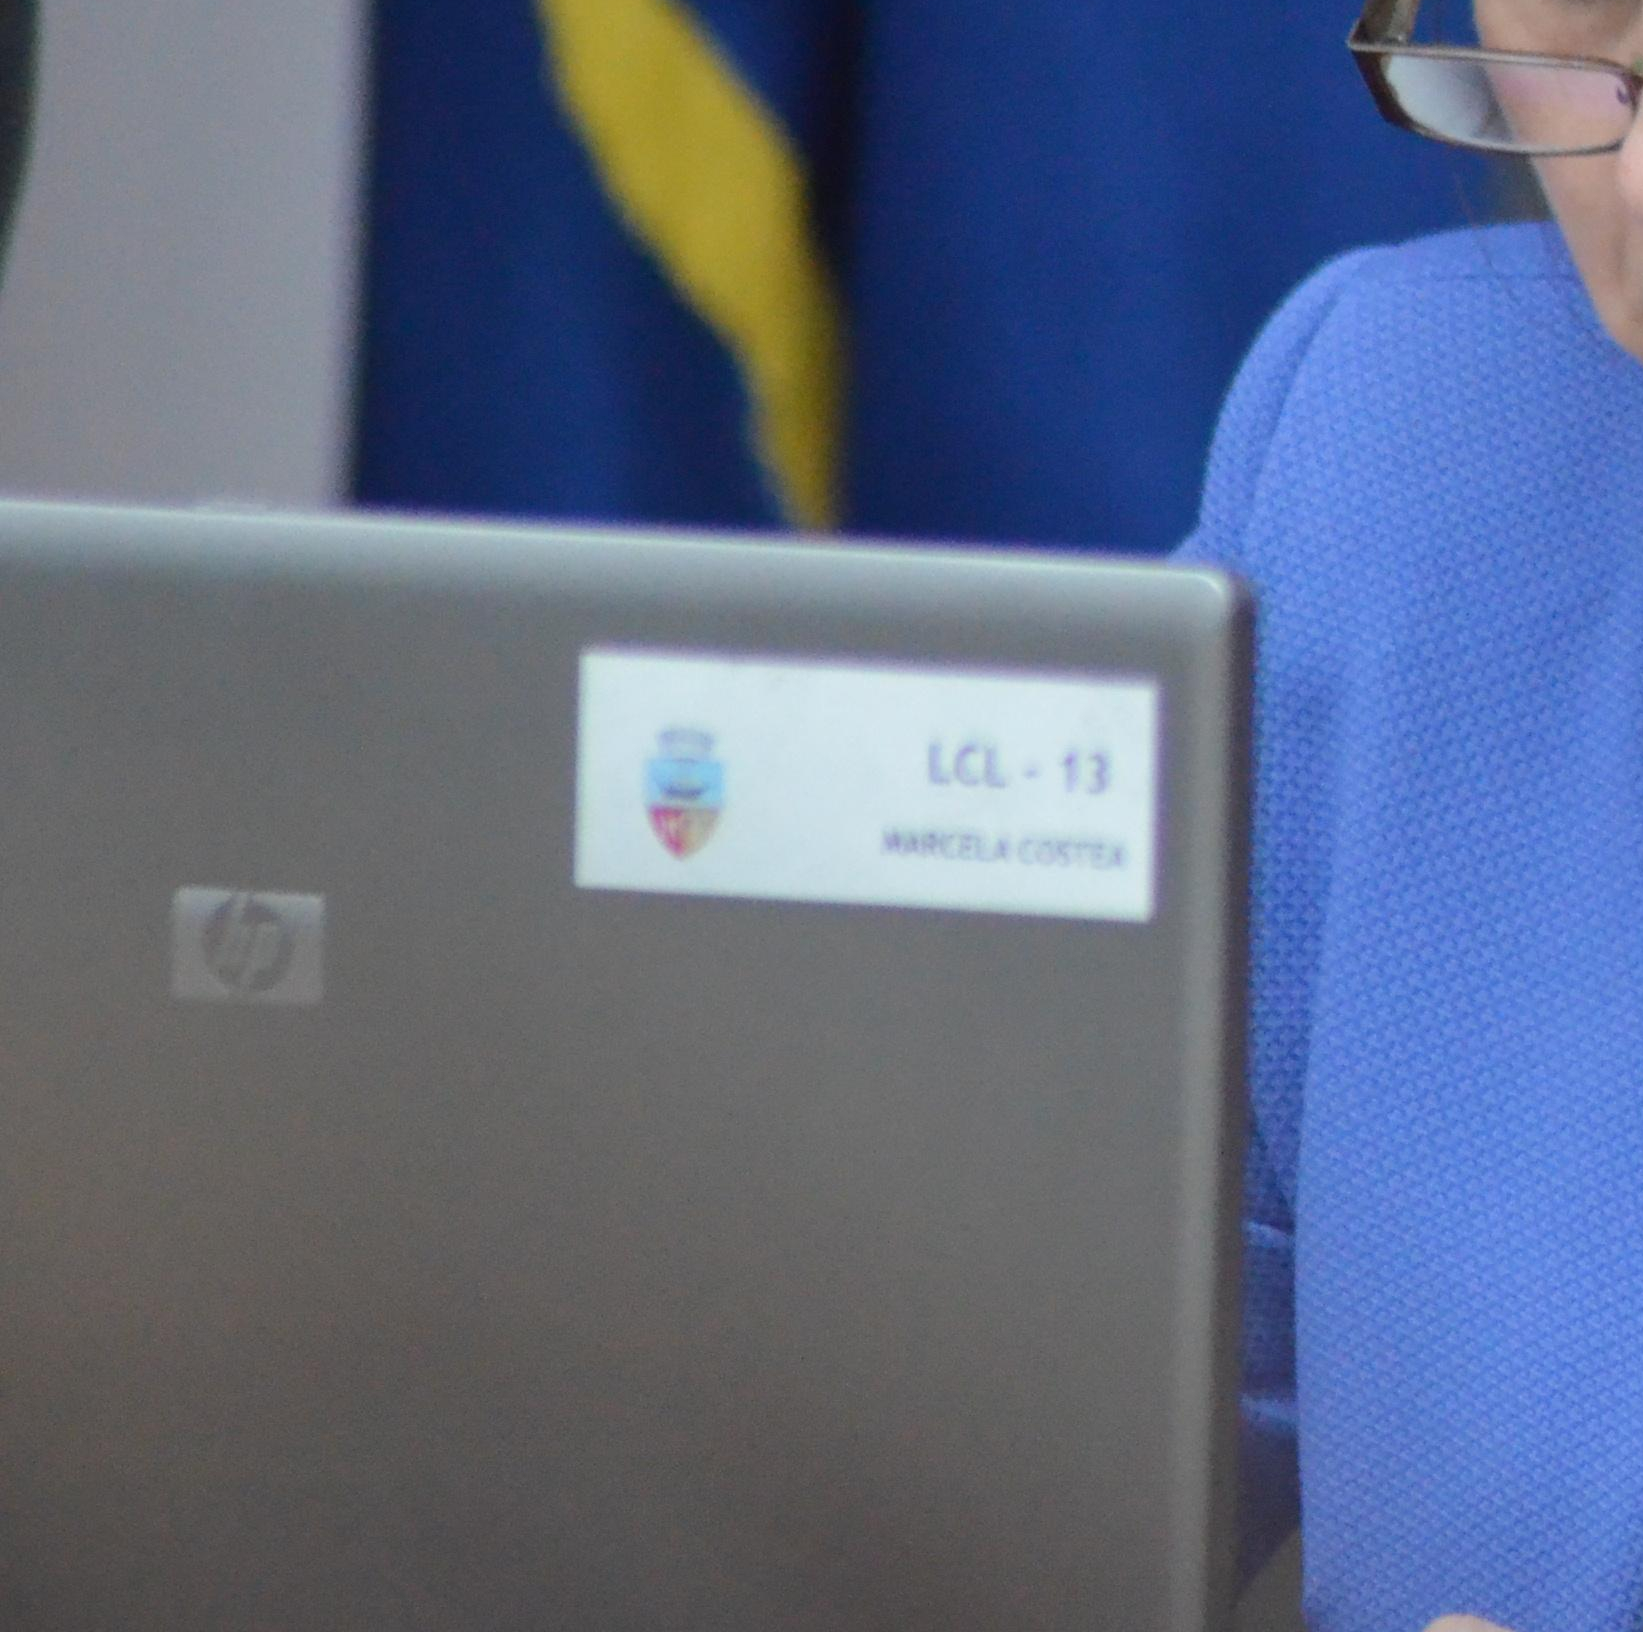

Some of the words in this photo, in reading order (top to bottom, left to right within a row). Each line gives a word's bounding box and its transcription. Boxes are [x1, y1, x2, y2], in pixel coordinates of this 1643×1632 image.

[927, 742, 1007, 789] LCL
[1060, 748, 1113, 794] 13
[880, 828, 1009, 863] MARCELA
[1017, 837, 1127, 870] COSTEA
